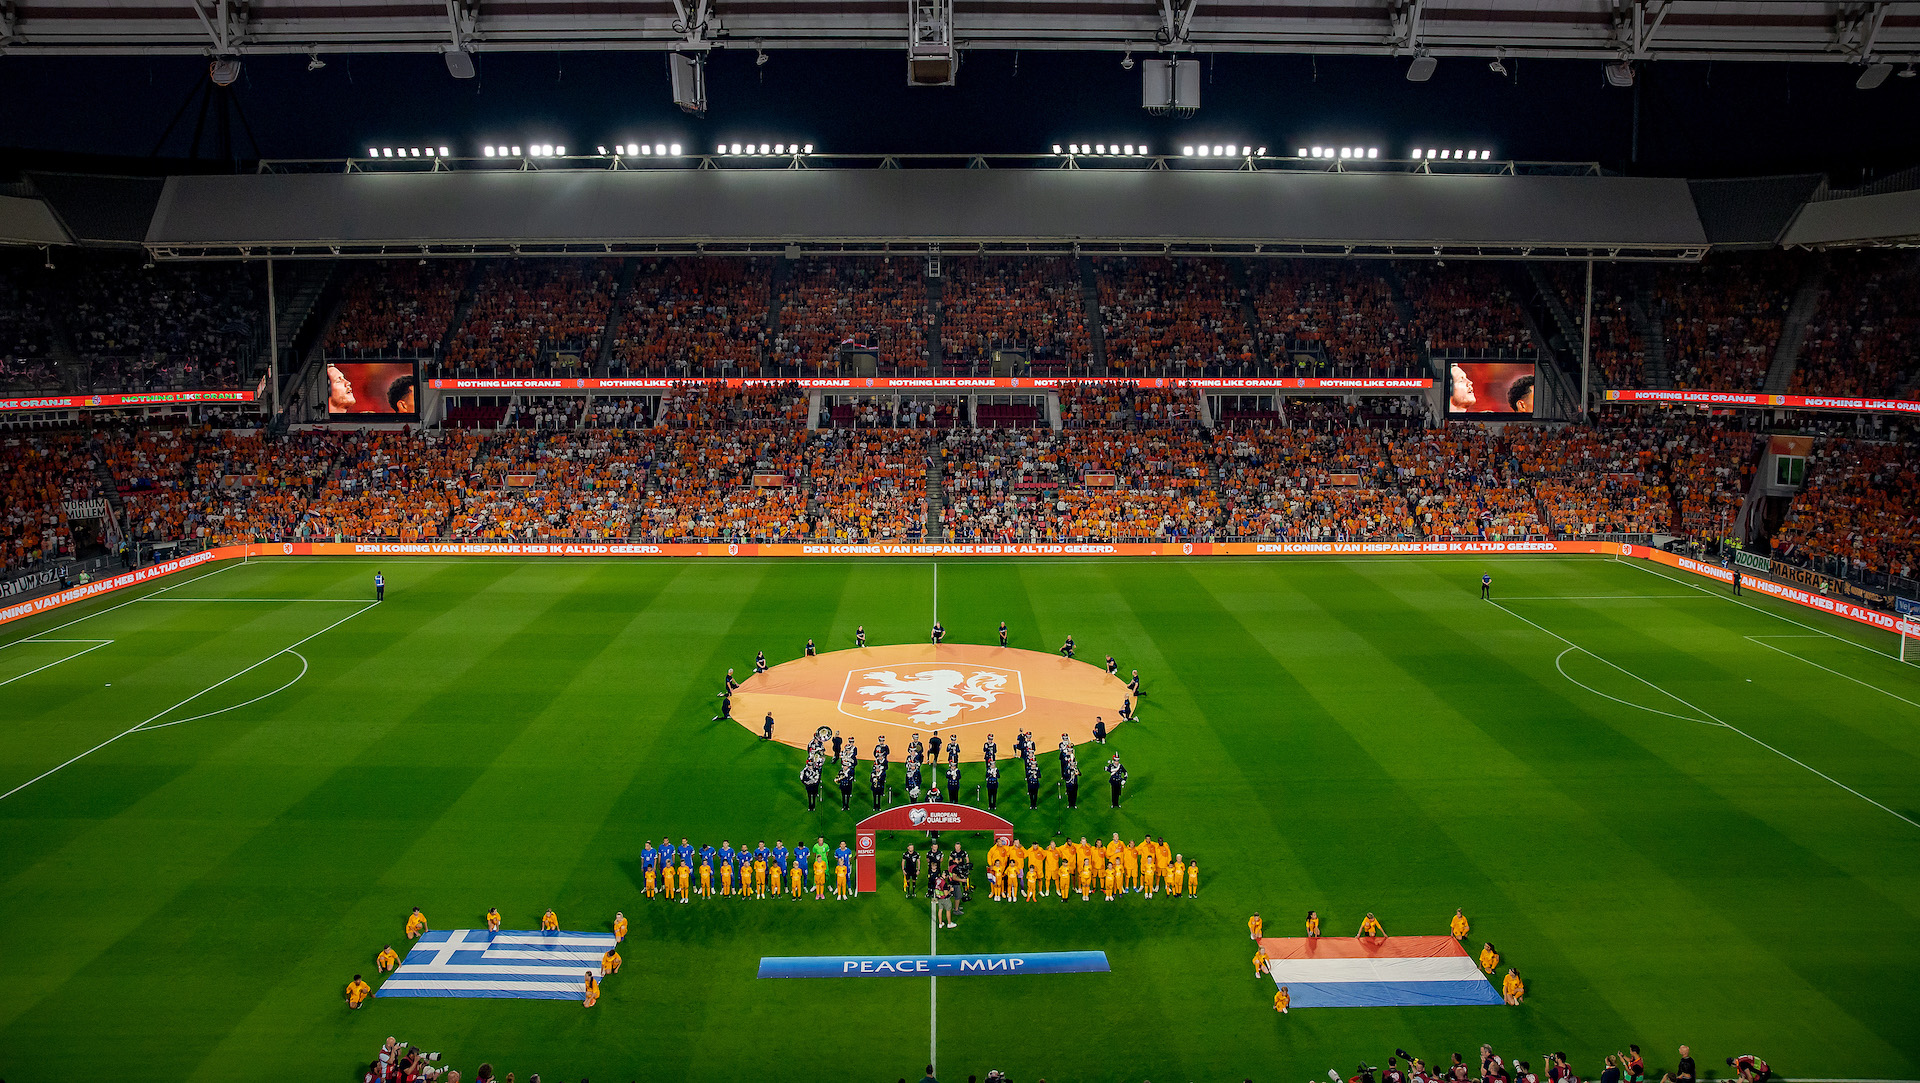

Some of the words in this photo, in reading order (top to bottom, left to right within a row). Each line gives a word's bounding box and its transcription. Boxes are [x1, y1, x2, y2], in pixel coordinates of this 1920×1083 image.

[121, 394, 174, 403] NOTHING
[1711, 394, 1756, 402] ORANJE
[20, 399, 71, 407] ORANJE
[1805, 398, 1862, 408] NOTHING
[610, 545, 662, 553] GEËERD.
[1064, 544, 1117, 553] GEËERD.
[1507, 542, 1557, 550] GEËERD.
[34, 595, 60, 610] VAN
[61, 580, 113, 602] HISPANJE
[114, 575, 134, 587] HEB
[136, 571, 146, 580] IK
[147, 562, 178, 578] ALTIJD
[179, 552, 215, 568] GEËERD.
[1679, 558, 1696, 570] DEN
[1697, 564, 1733, 580] KONING
[1740, 576, 1756, 588] AN
[1757, 580, 1808, 603] HISPANJE
[1810, 596, 1834, 610] HEB
[1836, 603, 1848, 614] IK
[1850, 608, 1893, 627] ALTIJD
[843, 961, 930, 973] PEACE
[960, 959, 1024, 972] МИР
